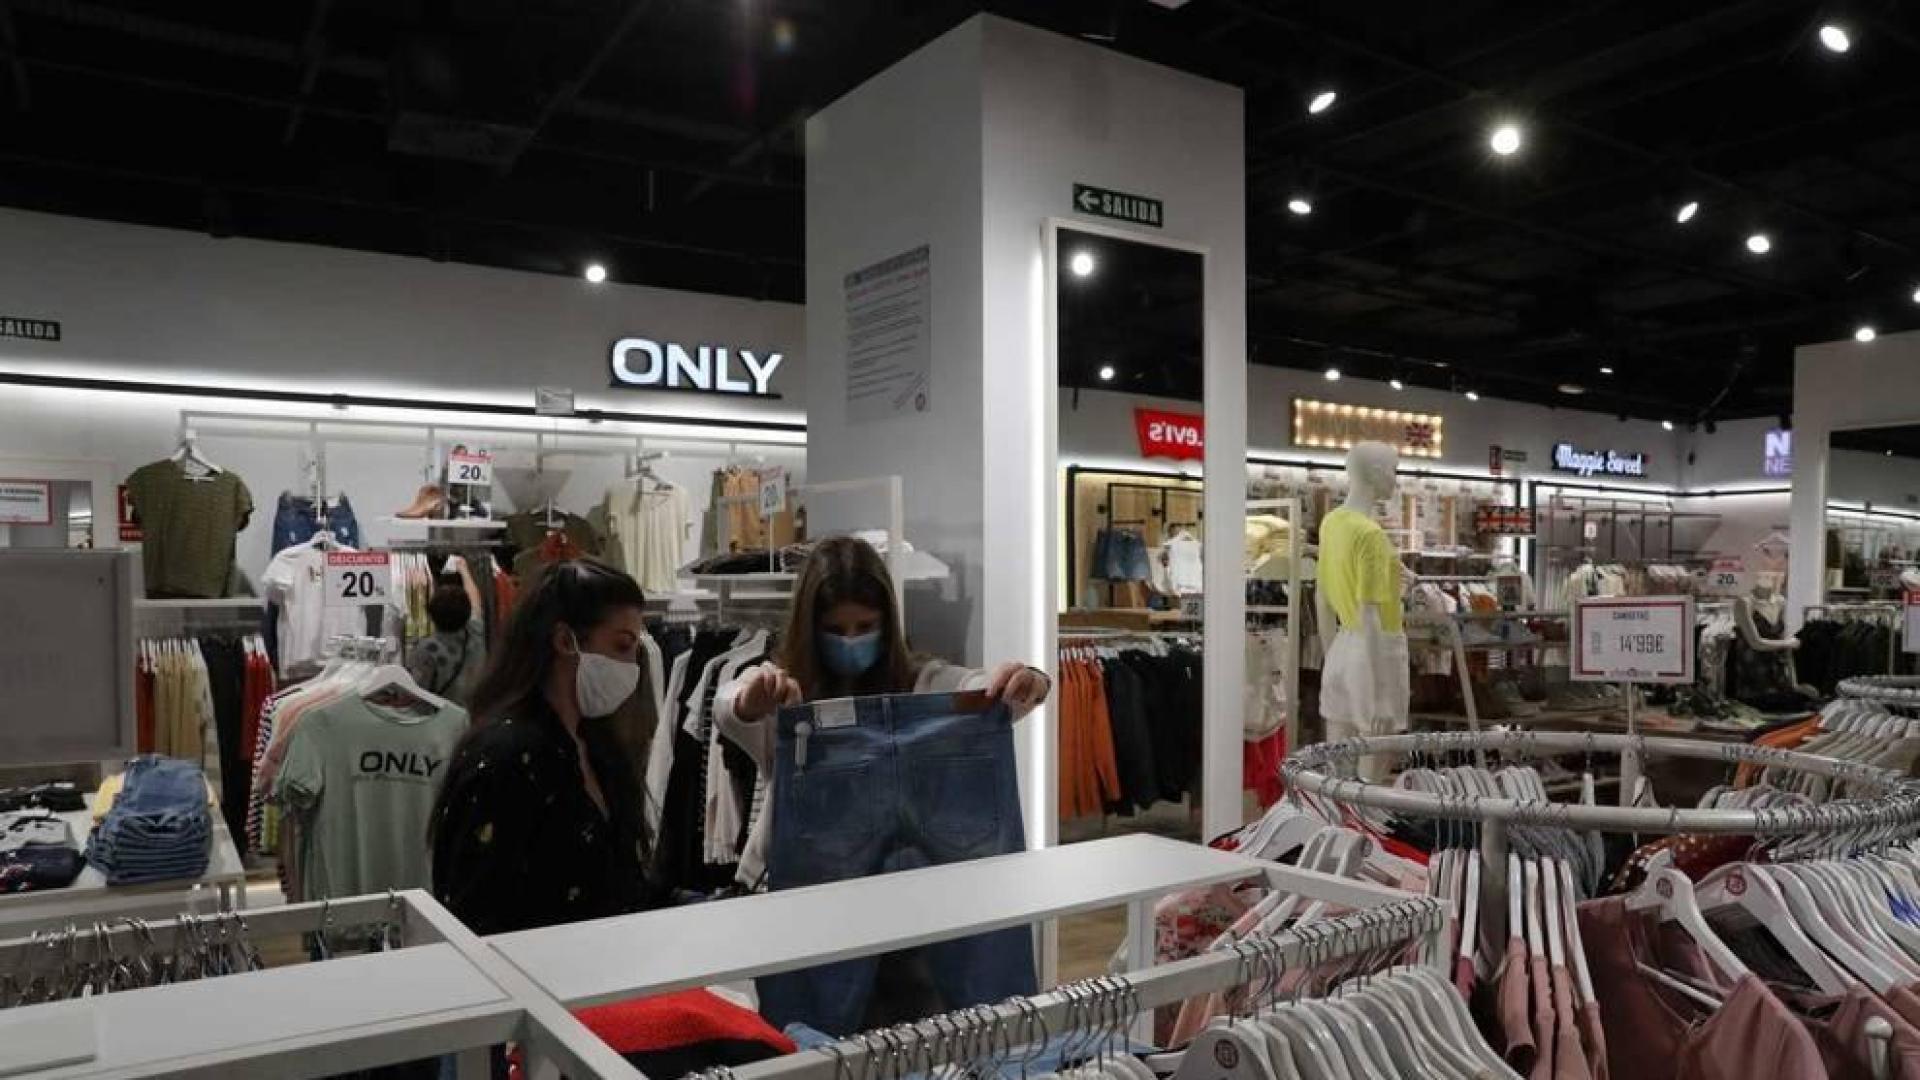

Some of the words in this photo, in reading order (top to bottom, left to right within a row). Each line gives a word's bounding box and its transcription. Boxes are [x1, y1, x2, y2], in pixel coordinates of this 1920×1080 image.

[1102, 193, 1159, 223] SALIDA
[612, 337, 783, 394] ONLY
[360, 751, 442, 777] ONLY
